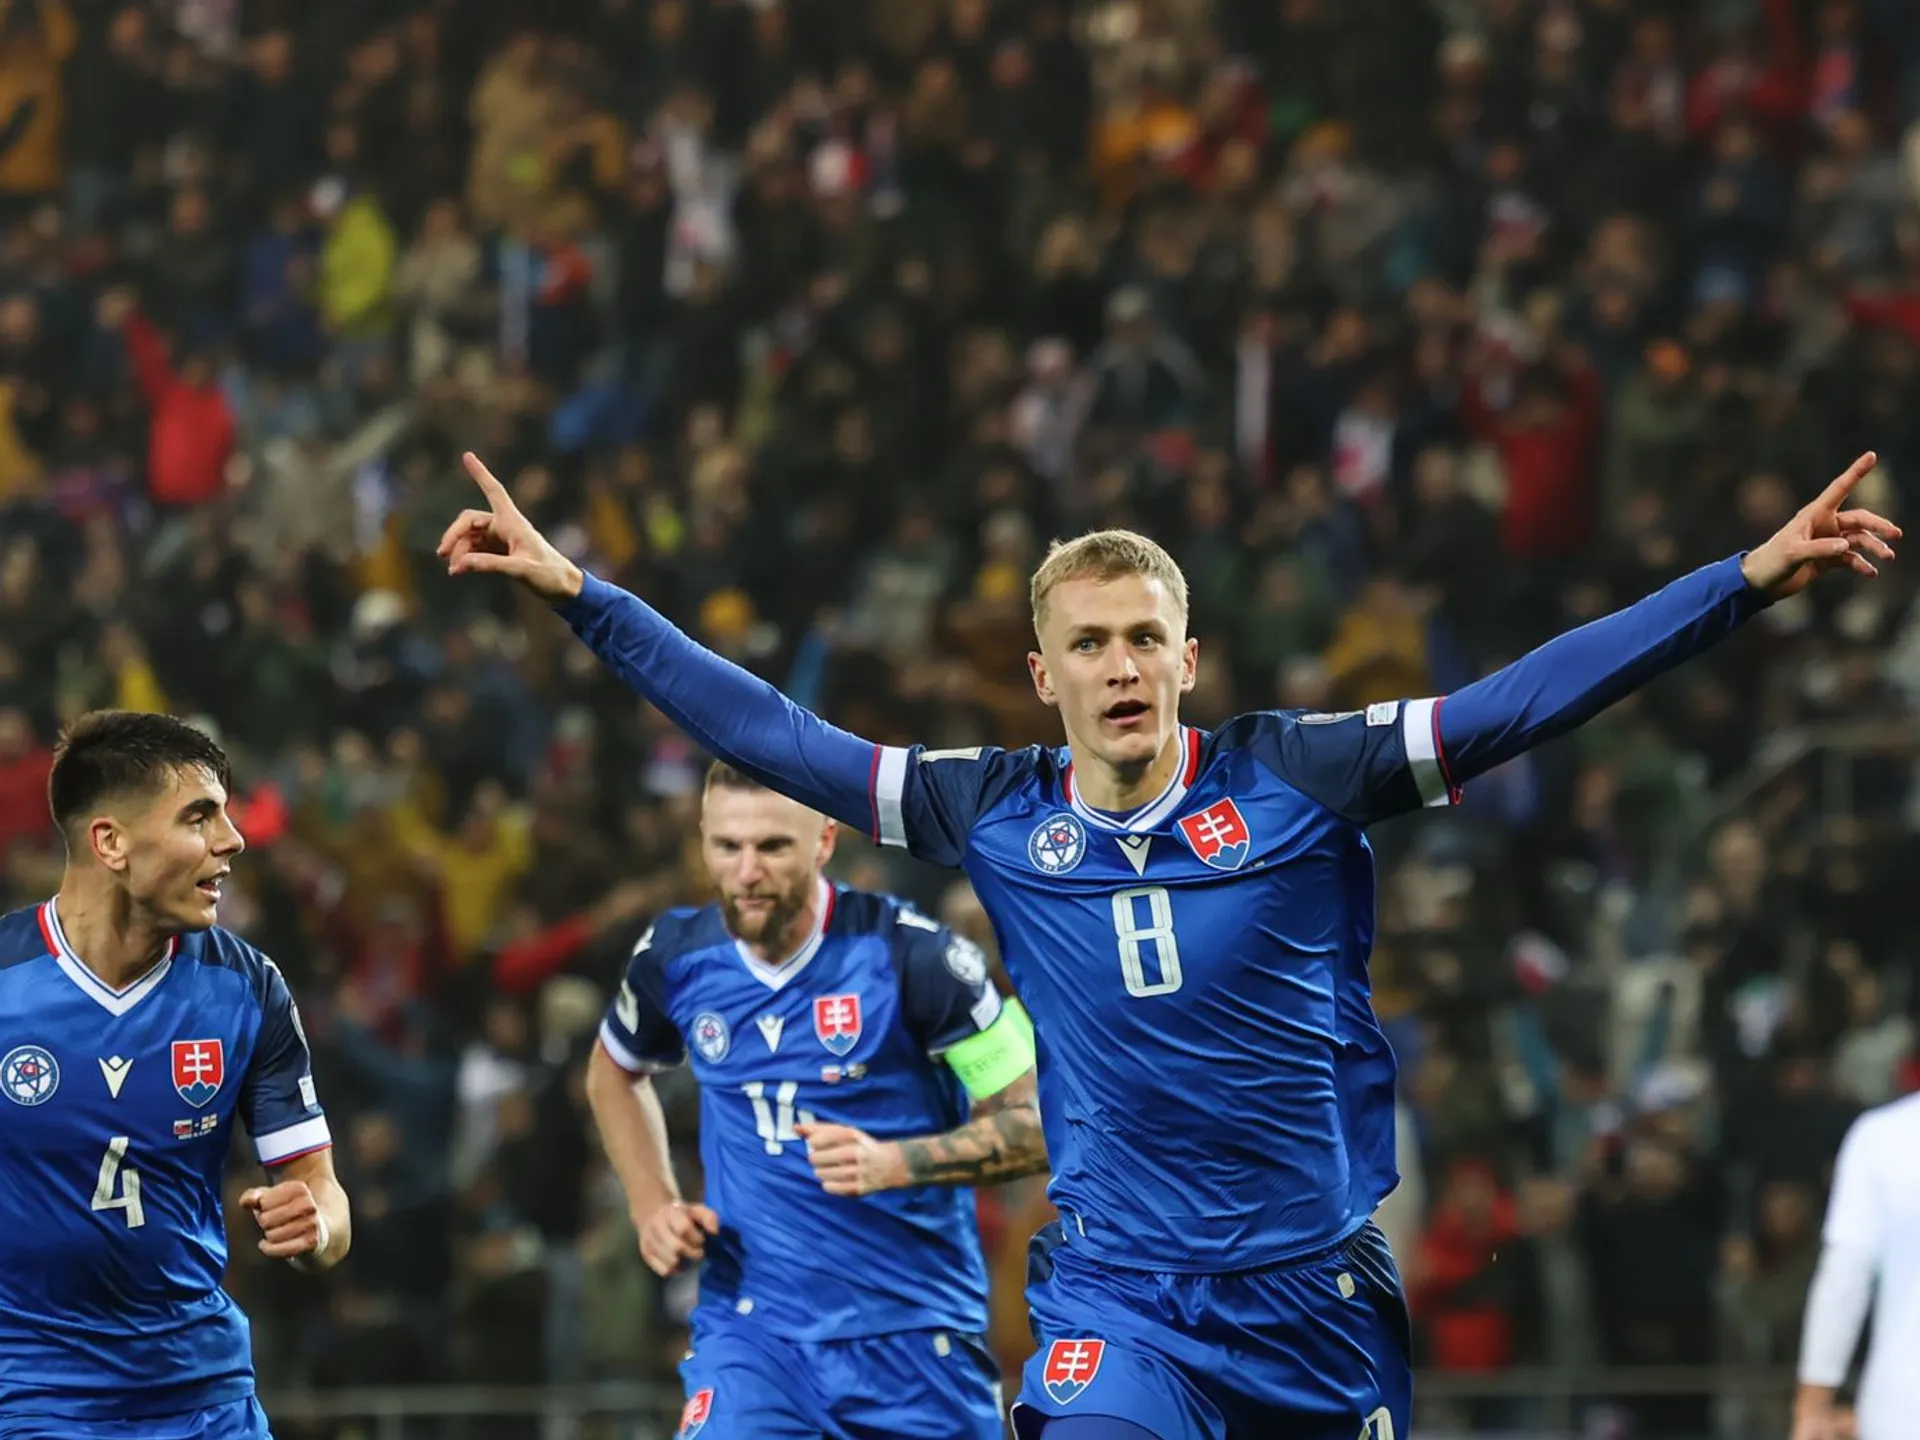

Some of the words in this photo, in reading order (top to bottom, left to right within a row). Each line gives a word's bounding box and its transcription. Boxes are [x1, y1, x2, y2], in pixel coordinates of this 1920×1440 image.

[1112, 887, 1183, 998] 8
[741, 1081, 815, 1156] 14
[91, 1136, 146, 1229] 4
